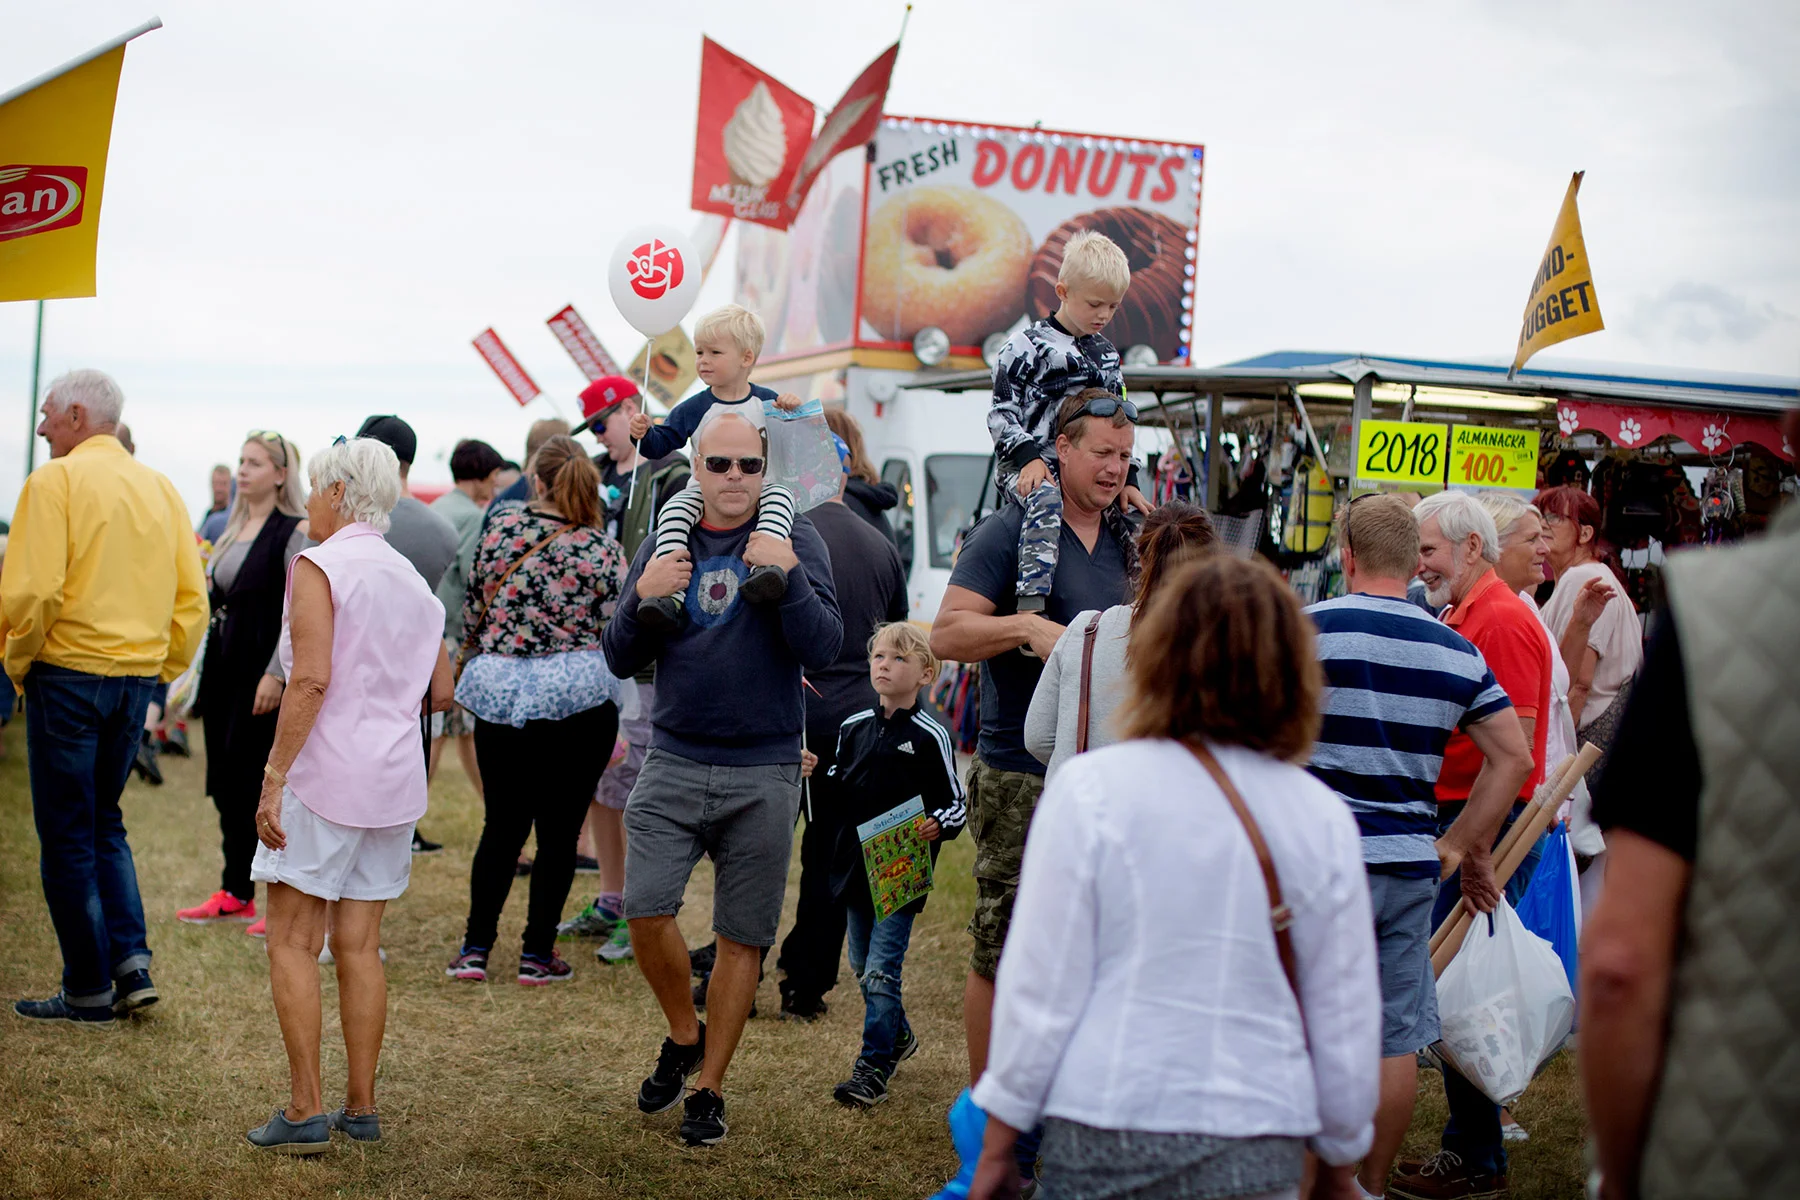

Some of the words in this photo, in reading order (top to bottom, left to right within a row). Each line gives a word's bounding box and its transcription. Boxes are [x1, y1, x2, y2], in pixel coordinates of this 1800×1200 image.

[877, 139, 959, 191] FRESH
[971, 139, 1186, 203] DONUTS
[1365, 430, 1439, 477] 2018
[1457, 429, 1527, 449] ALMANACKA
